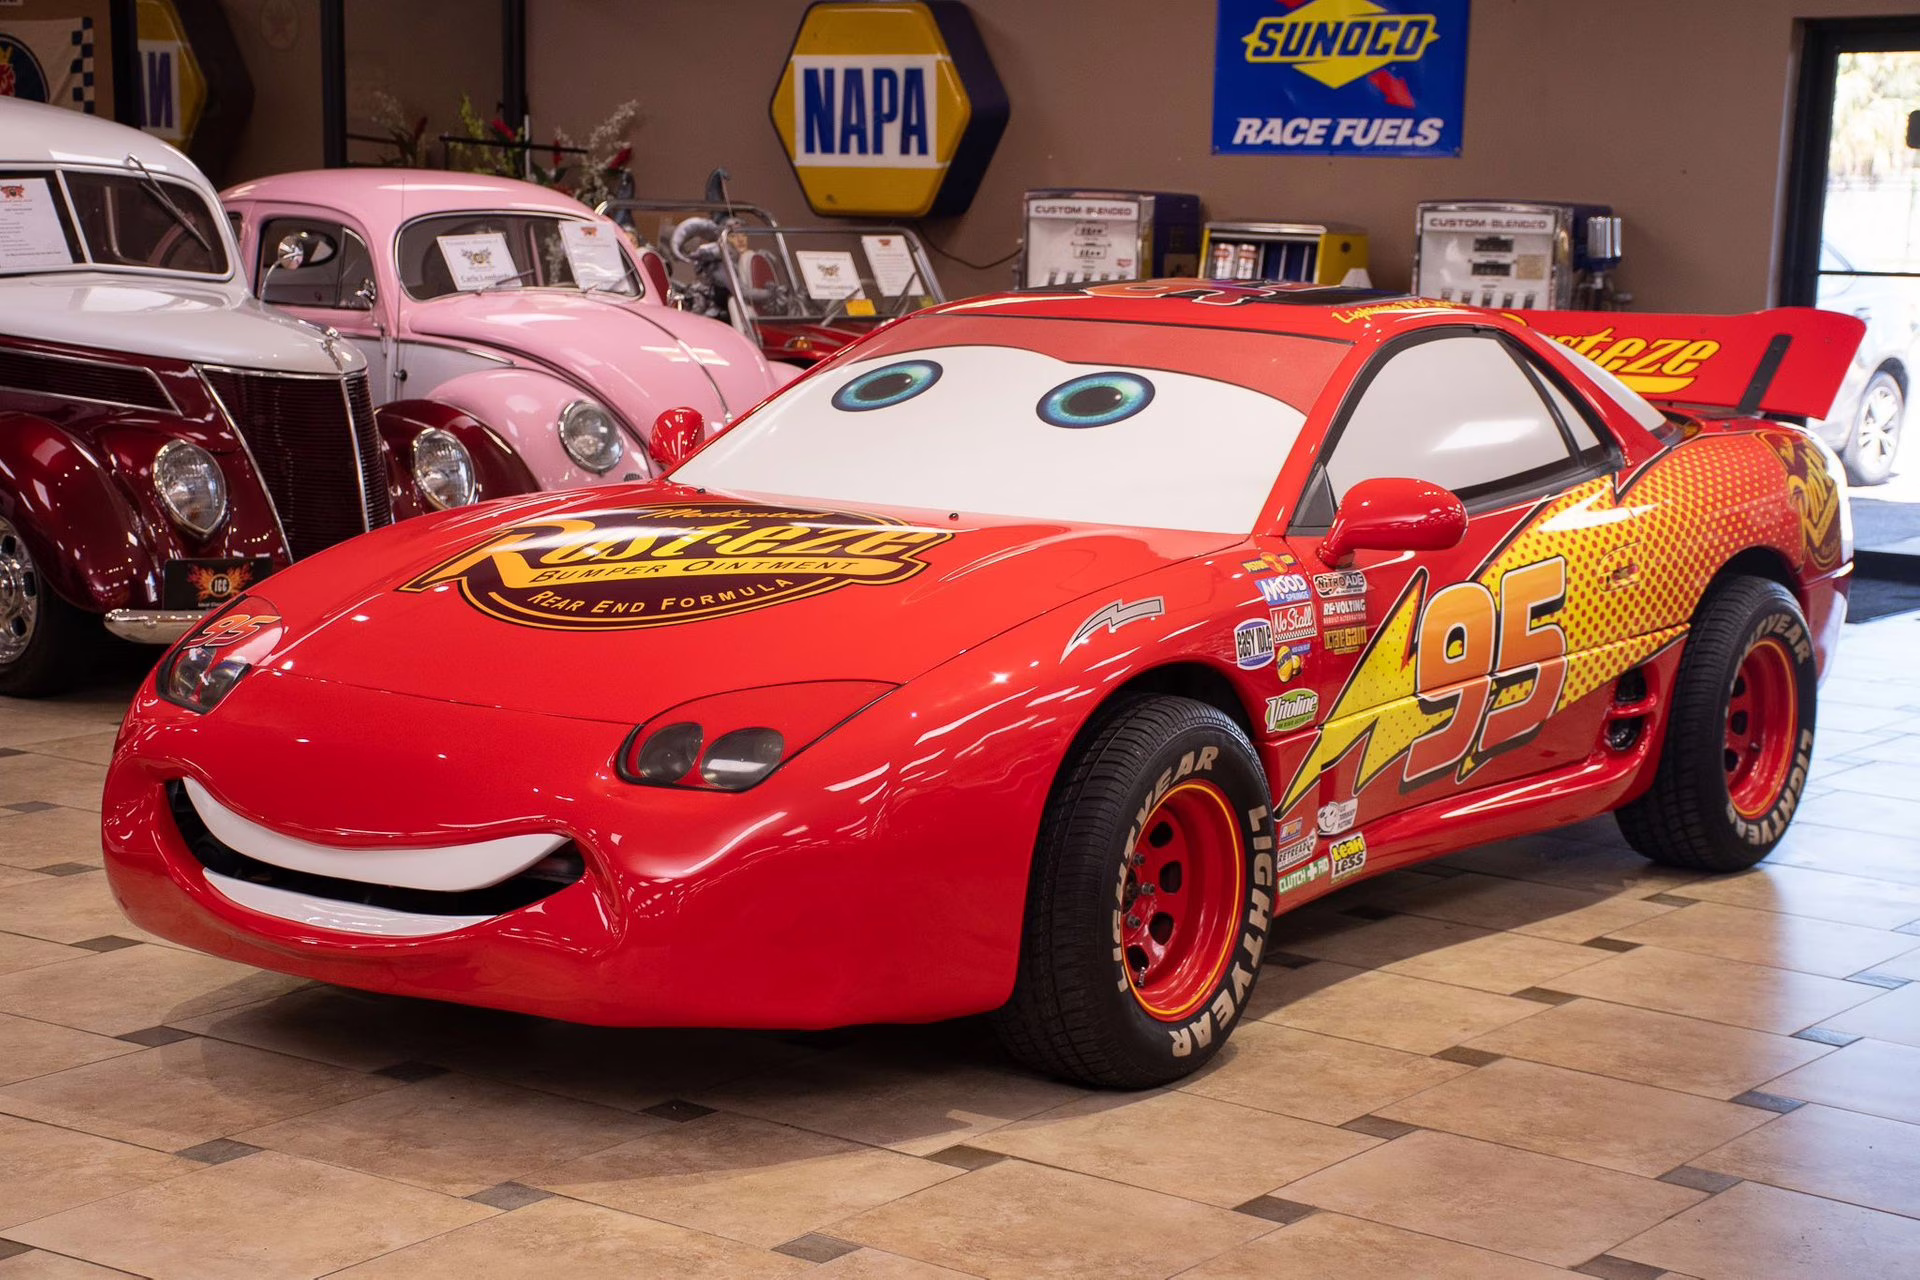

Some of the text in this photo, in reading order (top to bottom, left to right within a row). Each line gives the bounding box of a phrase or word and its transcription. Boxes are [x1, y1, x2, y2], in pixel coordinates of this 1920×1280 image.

[1251, 19, 1430, 58] SUNOCO
[803, 67, 929, 156] NAPA
[1231, 117, 1445, 147] RACE FUELS
[1034, 205, 1082, 215] CUSTOM
[1429, 217, 1486, 228] CUSTOM
[213, 578, 228, 593] ICC
[528, 560, 861, 584] BUMPER OINTMENT
[1260, 574, 1307, 602] MOOD
[527, 577, 794, 614] REAR END FORMULA
[182, 614, 283, 650] 95
[1274, 605, 1314, 634] No Stall
[1403, 555, 1569, 785] 95
[1268, 694, 1317, 731] Vitoline
[1169, 804, 1273, 1058] LIGHTYEAR
